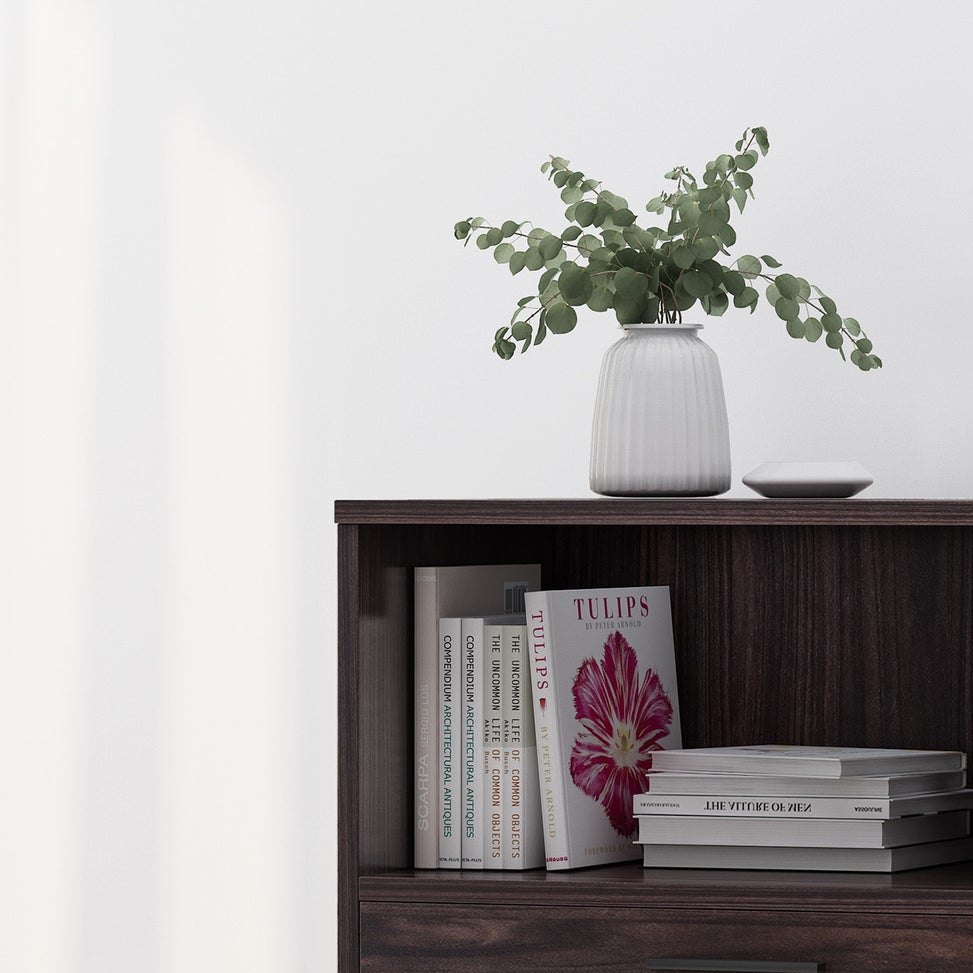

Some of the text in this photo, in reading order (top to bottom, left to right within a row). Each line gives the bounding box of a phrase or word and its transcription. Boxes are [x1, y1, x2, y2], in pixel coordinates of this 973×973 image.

[531, 610, 549, 690] TULIPS
[573, 595, 649, 621] TULIPS
[466, 635, 474, 838] COMPENDIUM ARCHITECTURAL ANTIQUES
[492, 635, 500, 859] THE UNCOMMON LIFE OF COMMON OBJECTS
[512, 635, 520, 859] THE UNCOMMON LIFE OF COMMON OBJECTS
[540, 726, 557, 839] BY PETER ARNOLD
[418, 753, 429, 831] SCARPA
[443, 787, 451, 837] ANTIQUES
